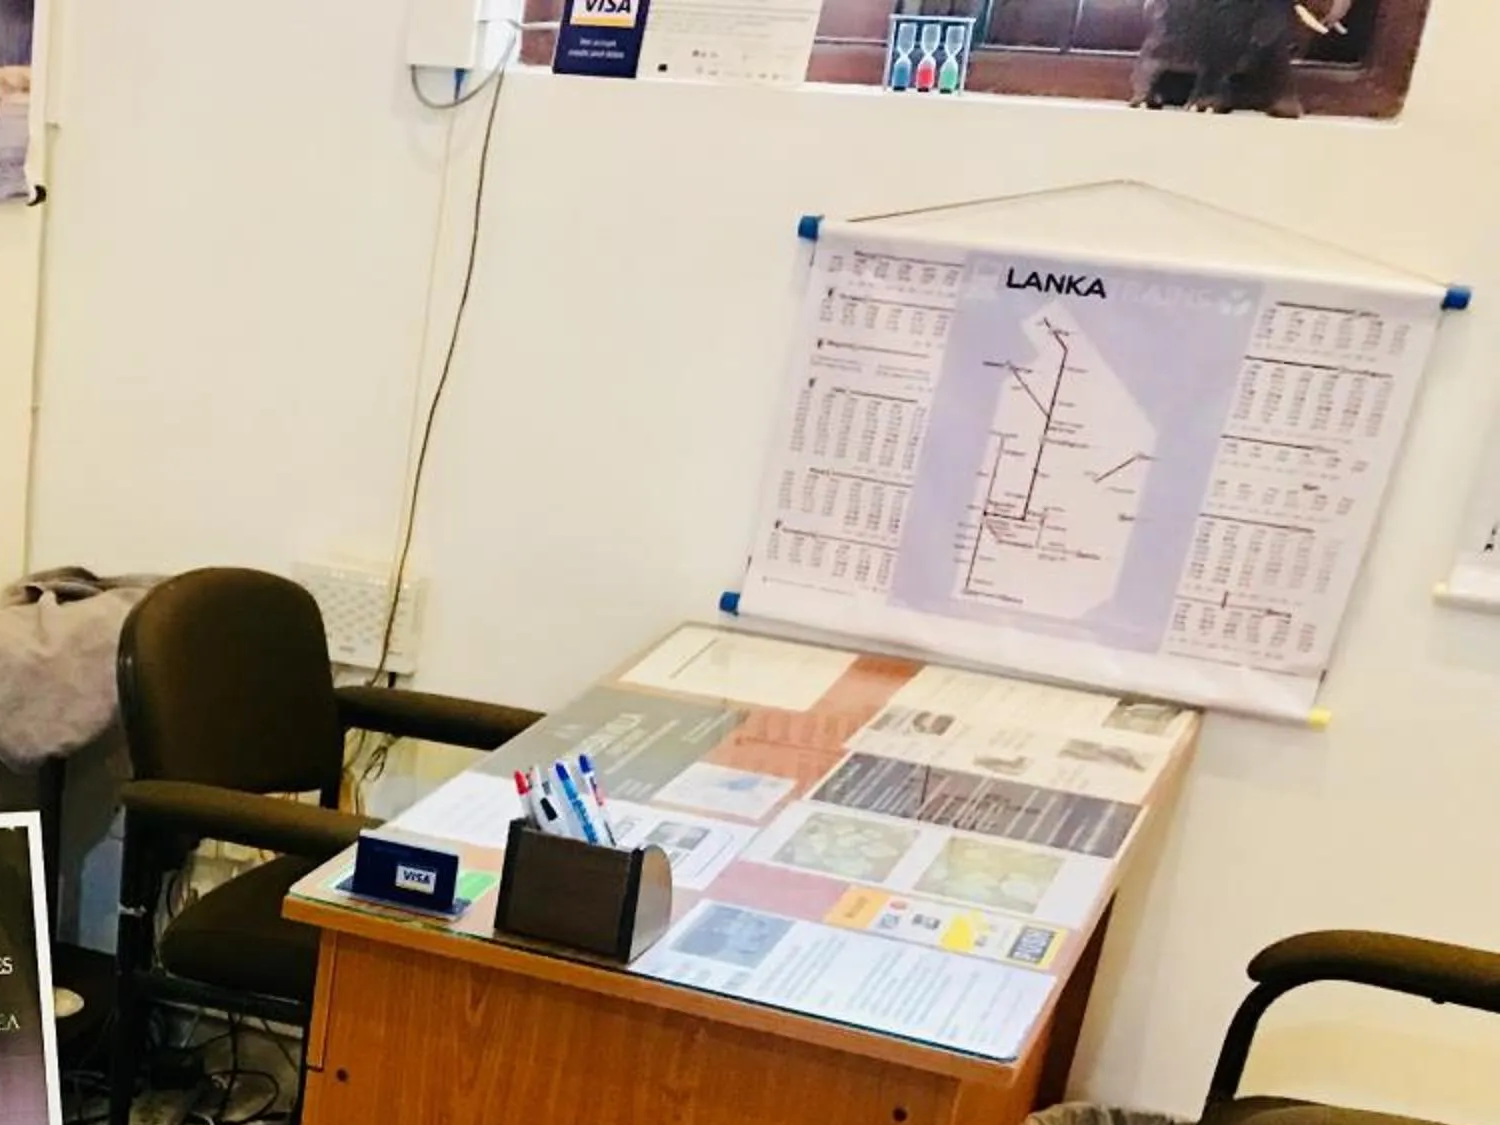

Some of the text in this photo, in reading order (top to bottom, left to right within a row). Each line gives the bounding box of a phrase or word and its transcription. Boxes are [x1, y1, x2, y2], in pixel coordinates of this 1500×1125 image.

[585, 0, 631, 13] VISA
[1005, 266, 1107, 300] LANKA
[403, 868, 432, 885] VISA
